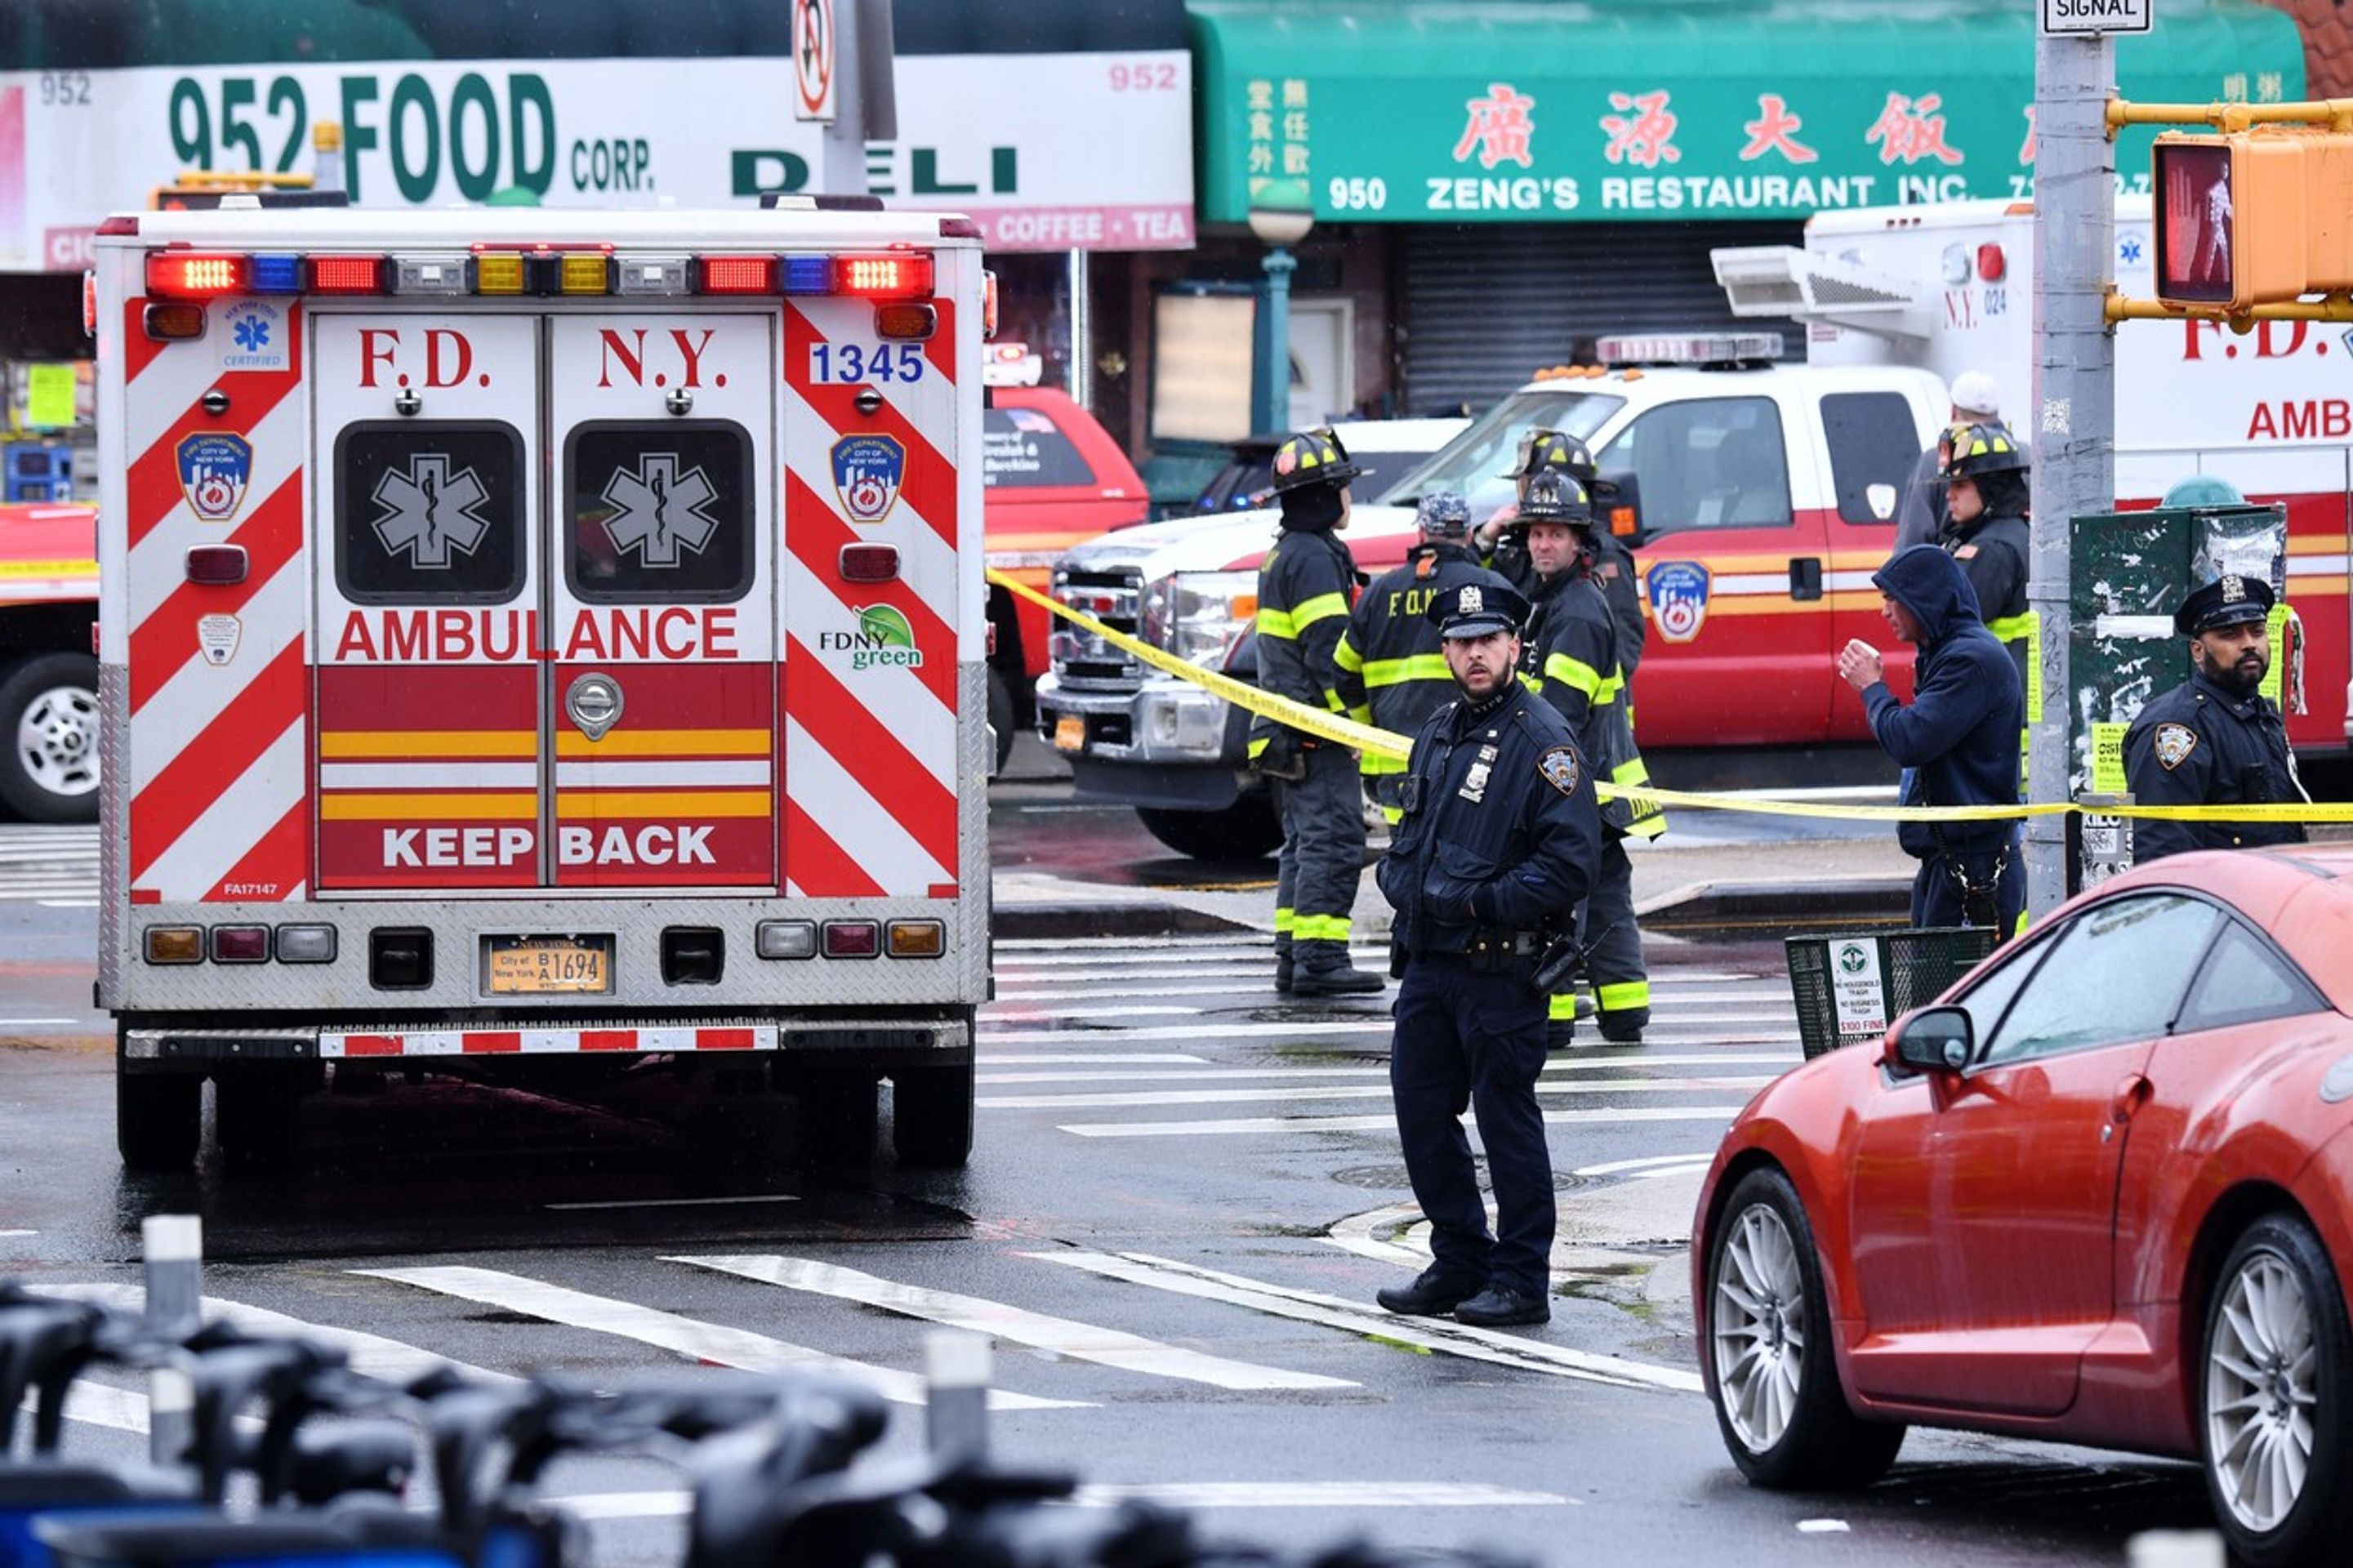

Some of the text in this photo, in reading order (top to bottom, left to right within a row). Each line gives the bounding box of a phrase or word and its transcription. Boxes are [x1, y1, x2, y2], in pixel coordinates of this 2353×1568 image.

[2057, 0, 2137, 17] SIGNAL
[41, 72, 91, 106] 952
[1108, 63, 1177, 91] 952
[169, 73, 654, 203] 952 FOOD CORP.
[1329, 177, 1386, 210] 950
[1426, 177, 1580, 210] ZENG'S
[1601, 175, 1875, 208] RESTAURANT
[997, 211, 1187, 243] COFFEE TEA
[1985, 288, 2006, 315] 024
[223, 355, 281, 367] CERTIFIED
[359, 329, 727, 388] F.D. N.Y.
[813, 344, 924, 383] 1345
[2247, 399, 2353, 440] AMB
[334, 607, 738, 662] AMBULANCE
[820, 632, 889, 651] FDNY
[853, 650, 920, 670] green
[382, 826, 717, 867] KEEP BACK
[224, 883, 279, 896] FA17147
[495, 969, 534, 978] New York
[500, 956, 530, 965] City of
[539, 953, 550, 966] B
[554, 952, 598, 980] 1694
[539, 968, 550, 980] A
[1840, 1018, 1885, 1031] $100 FINE
